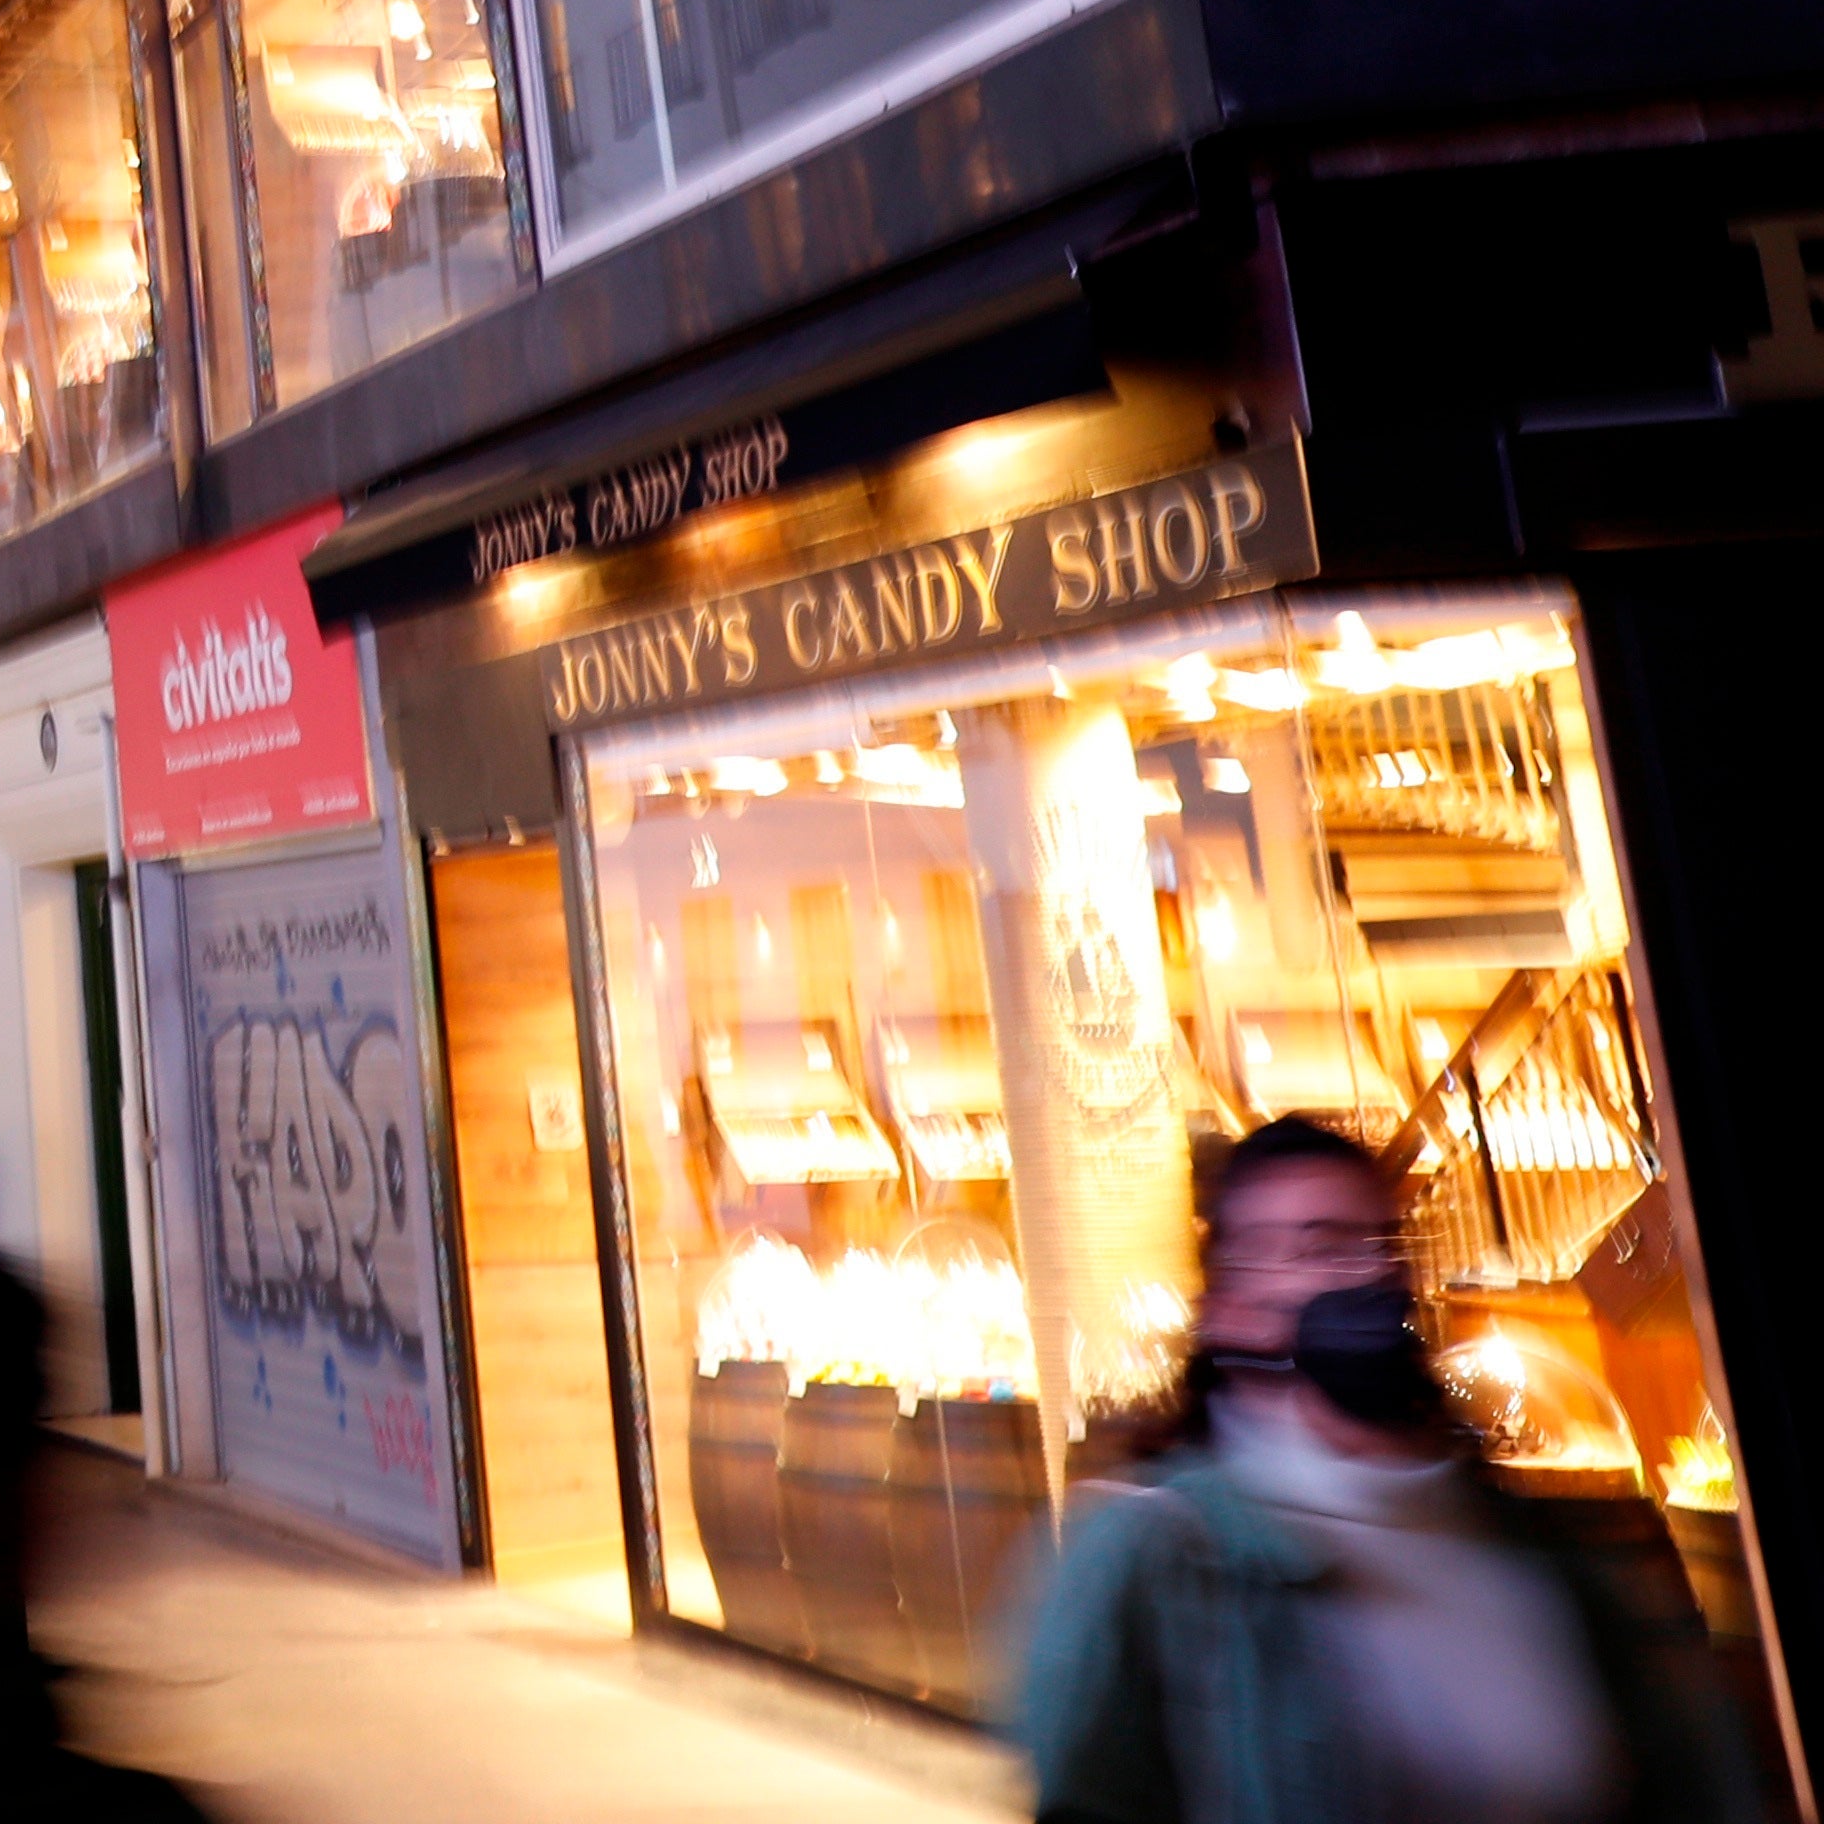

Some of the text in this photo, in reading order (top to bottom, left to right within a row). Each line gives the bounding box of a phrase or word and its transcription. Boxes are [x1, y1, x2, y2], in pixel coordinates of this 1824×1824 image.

[471, 419, 789, 585] JONNY'S CANDY SHOP
[162, 606, 293, 733] civitatis
[554, 464, 1268, 723] JONNY'S CANDY SHOP
